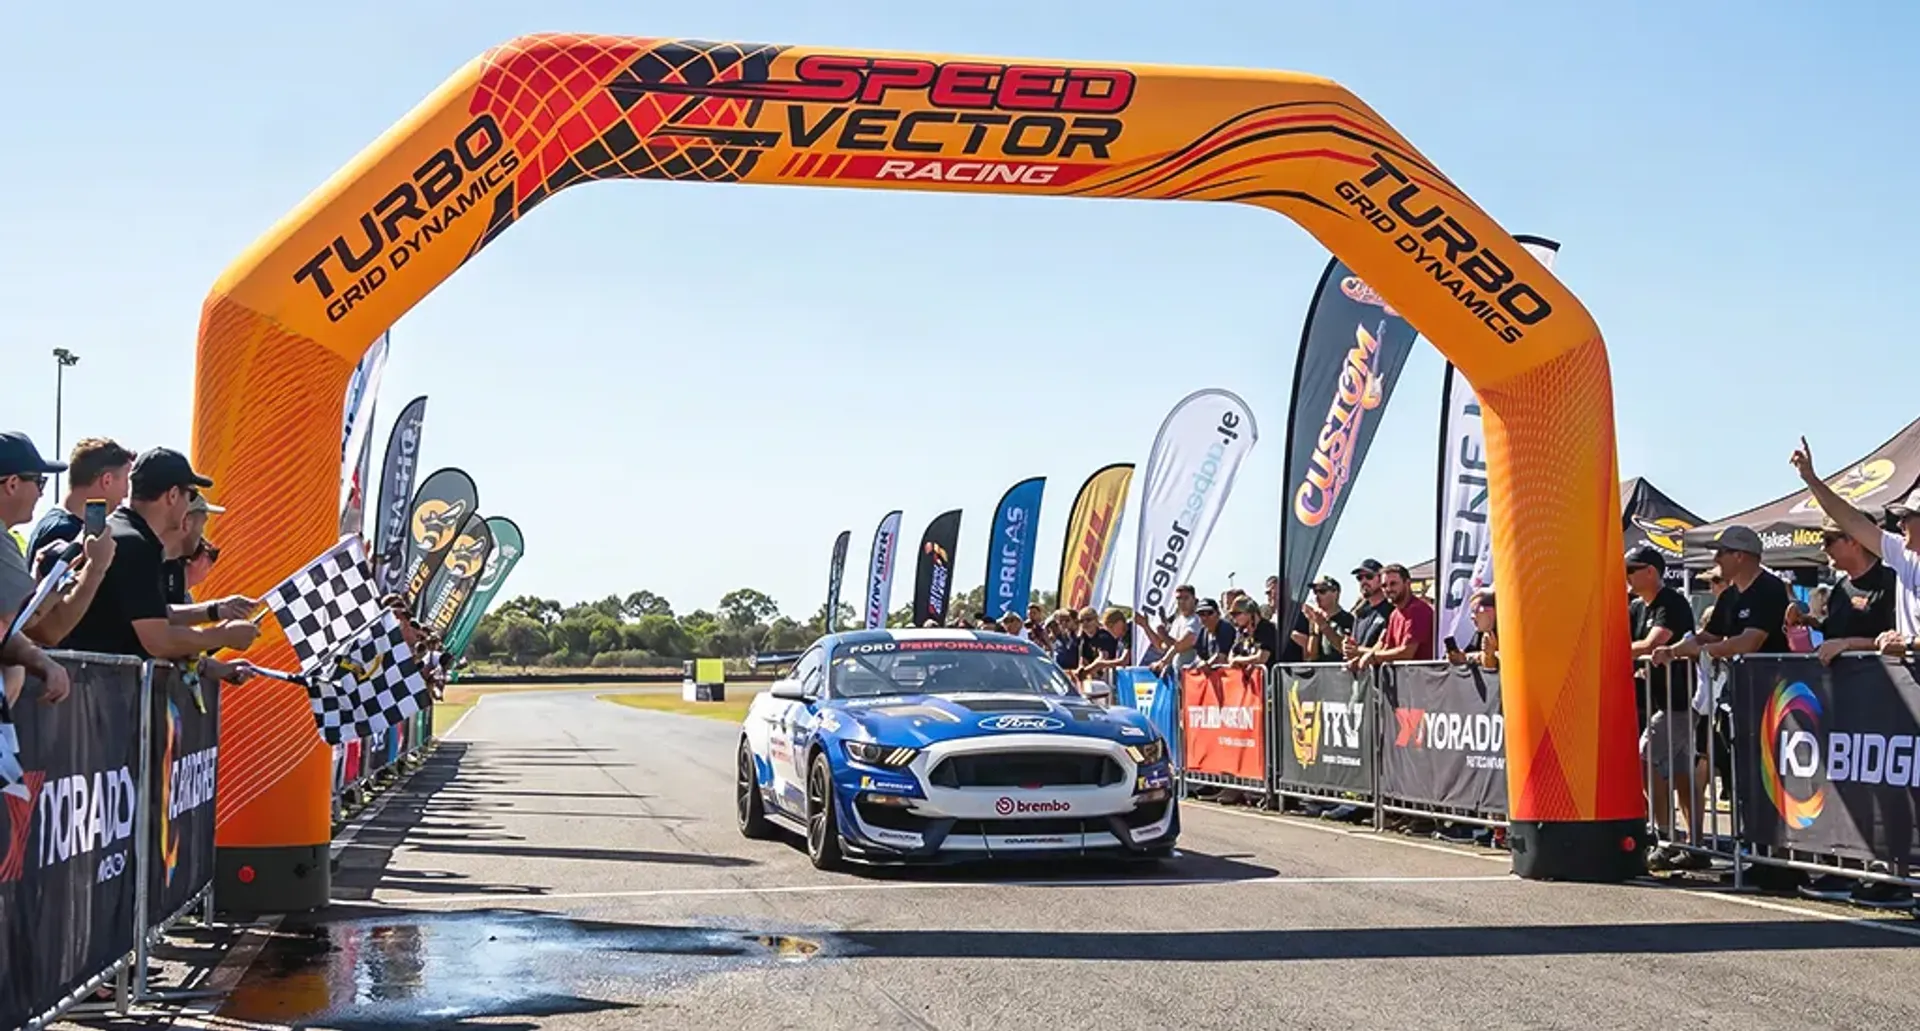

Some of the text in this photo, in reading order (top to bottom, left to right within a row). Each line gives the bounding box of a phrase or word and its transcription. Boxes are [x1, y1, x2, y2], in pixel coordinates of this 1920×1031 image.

[787, 105, 1123, 159] VECTOR
[793, 55, 1136, 115] SPEED
[294, 113, 504, 298] TURBO
[875, 160, 1059, 185] RACING
[326, 149, 520, 323] GRID DYNAMICS
[1334, 180, 1397, 234] GRID
[1394, 233, 1524, 345] DYNAMICS
[1360, 152, 1553, 326] TURBO
[1294, 323, 1379, 527] CUSTOM
[1069, 502, 1114, 611] DHL
[850, 641, 1030, 654] FORD PERFORMANCE
[1017, 799, 1071, 812] brembo
